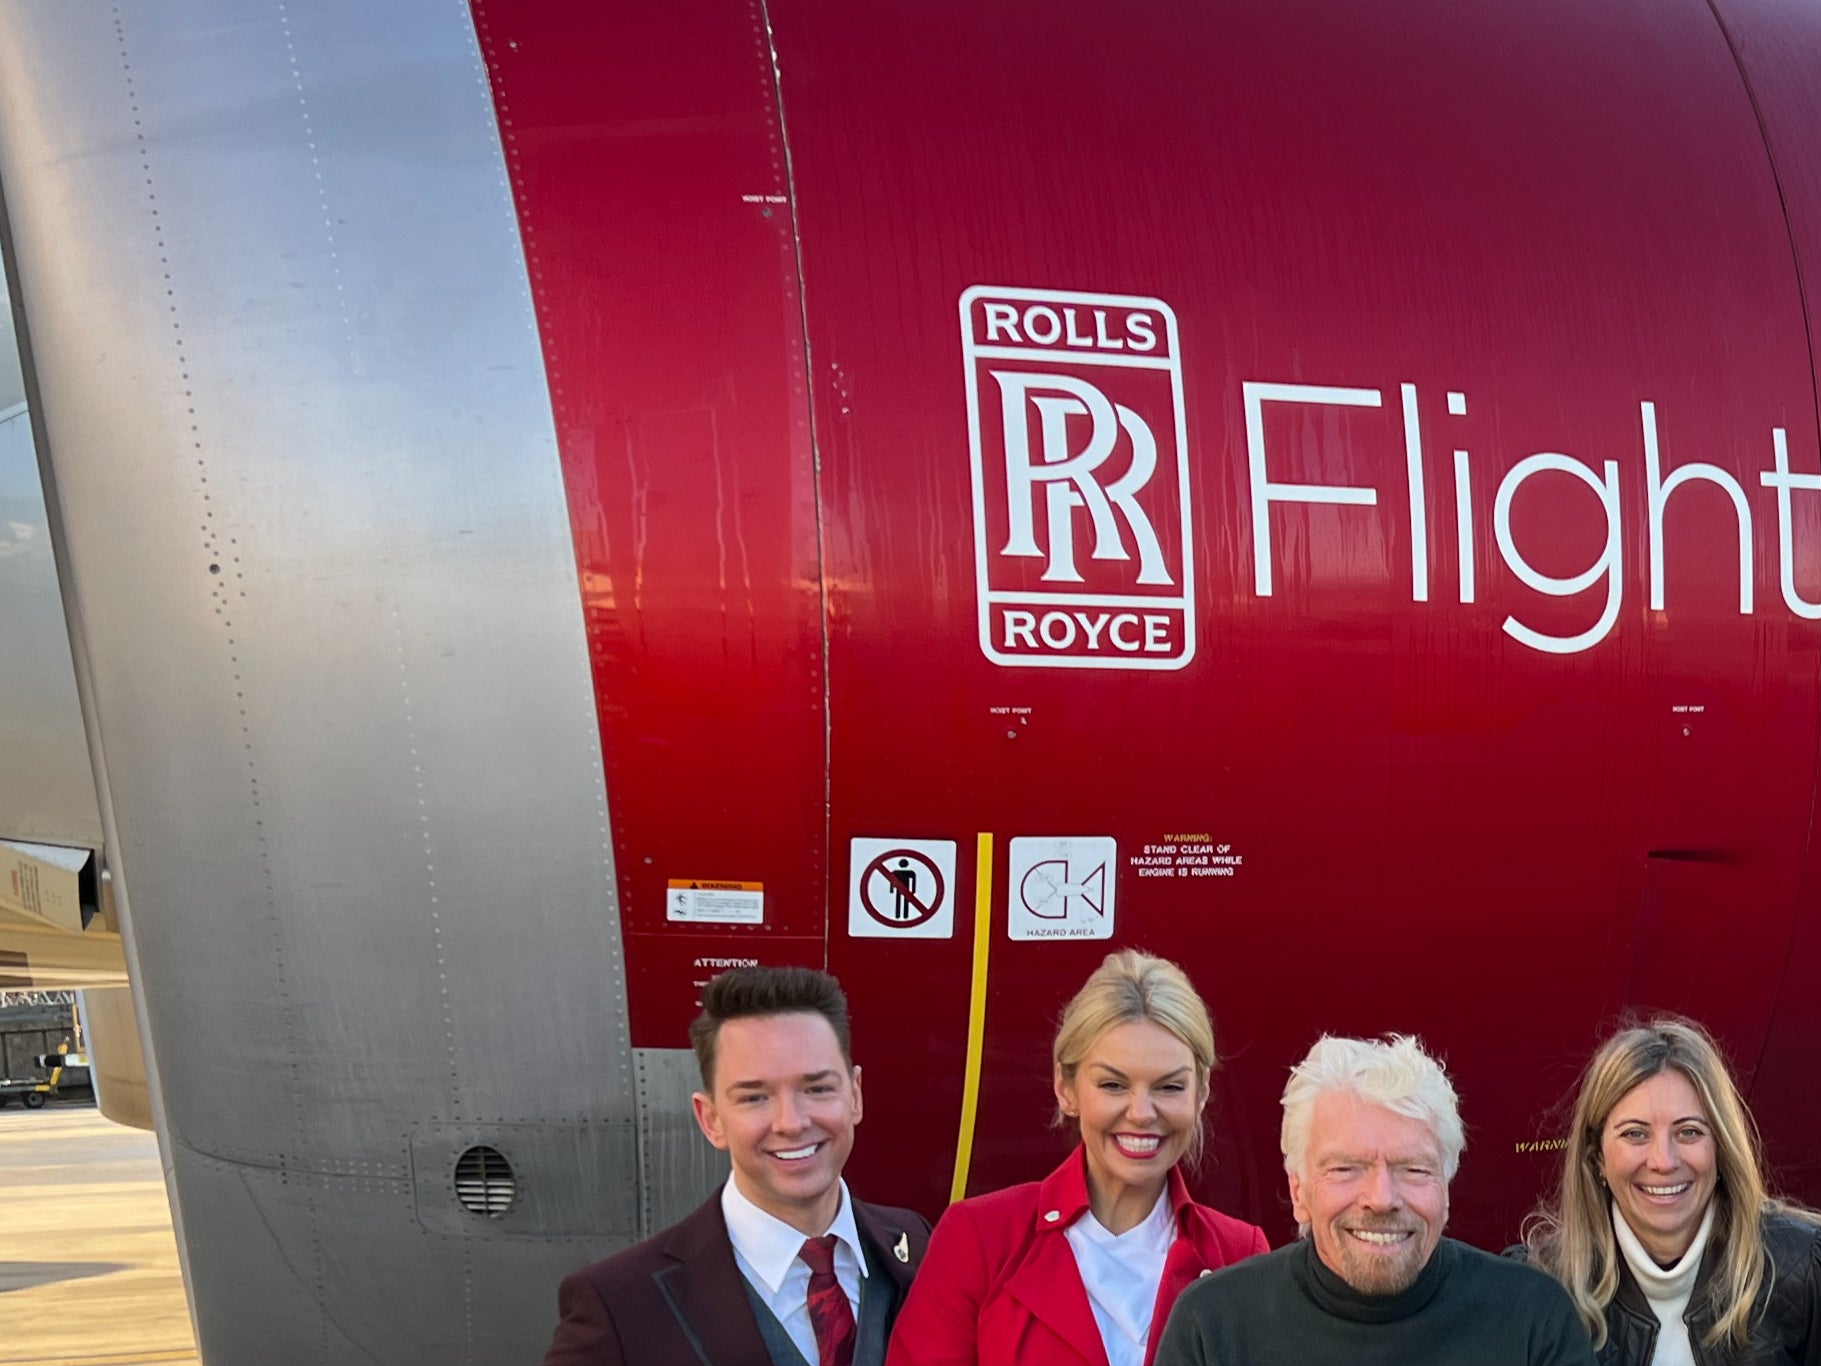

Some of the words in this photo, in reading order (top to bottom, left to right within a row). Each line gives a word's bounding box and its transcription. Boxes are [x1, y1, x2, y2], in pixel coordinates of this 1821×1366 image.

[983, 303, 1157, 351] ROLLS
[1003, 610, 1172, 652] ROYCE
[1143, 844, 1177, 854] STAND
[1179, 844, 1214, 854] CLEAR
[1216, 844, 1232, 854] OF
[1130, 856, 1173, 866] HAZARD
[1175, 855, 1209, 865] AREAS
[1211, 855, 1243, 865] WHILE
[1138, 867, 1175, 877] ENGINE
[1178, 867, 1188, 877] IS
[1191, 866, 1234, 877] RUNNING
[1026, 928, 1067, 937] HAZARD
[1069, 928, 1096, 937] AREA
[694, 957, 759, 968] ATTENTION
